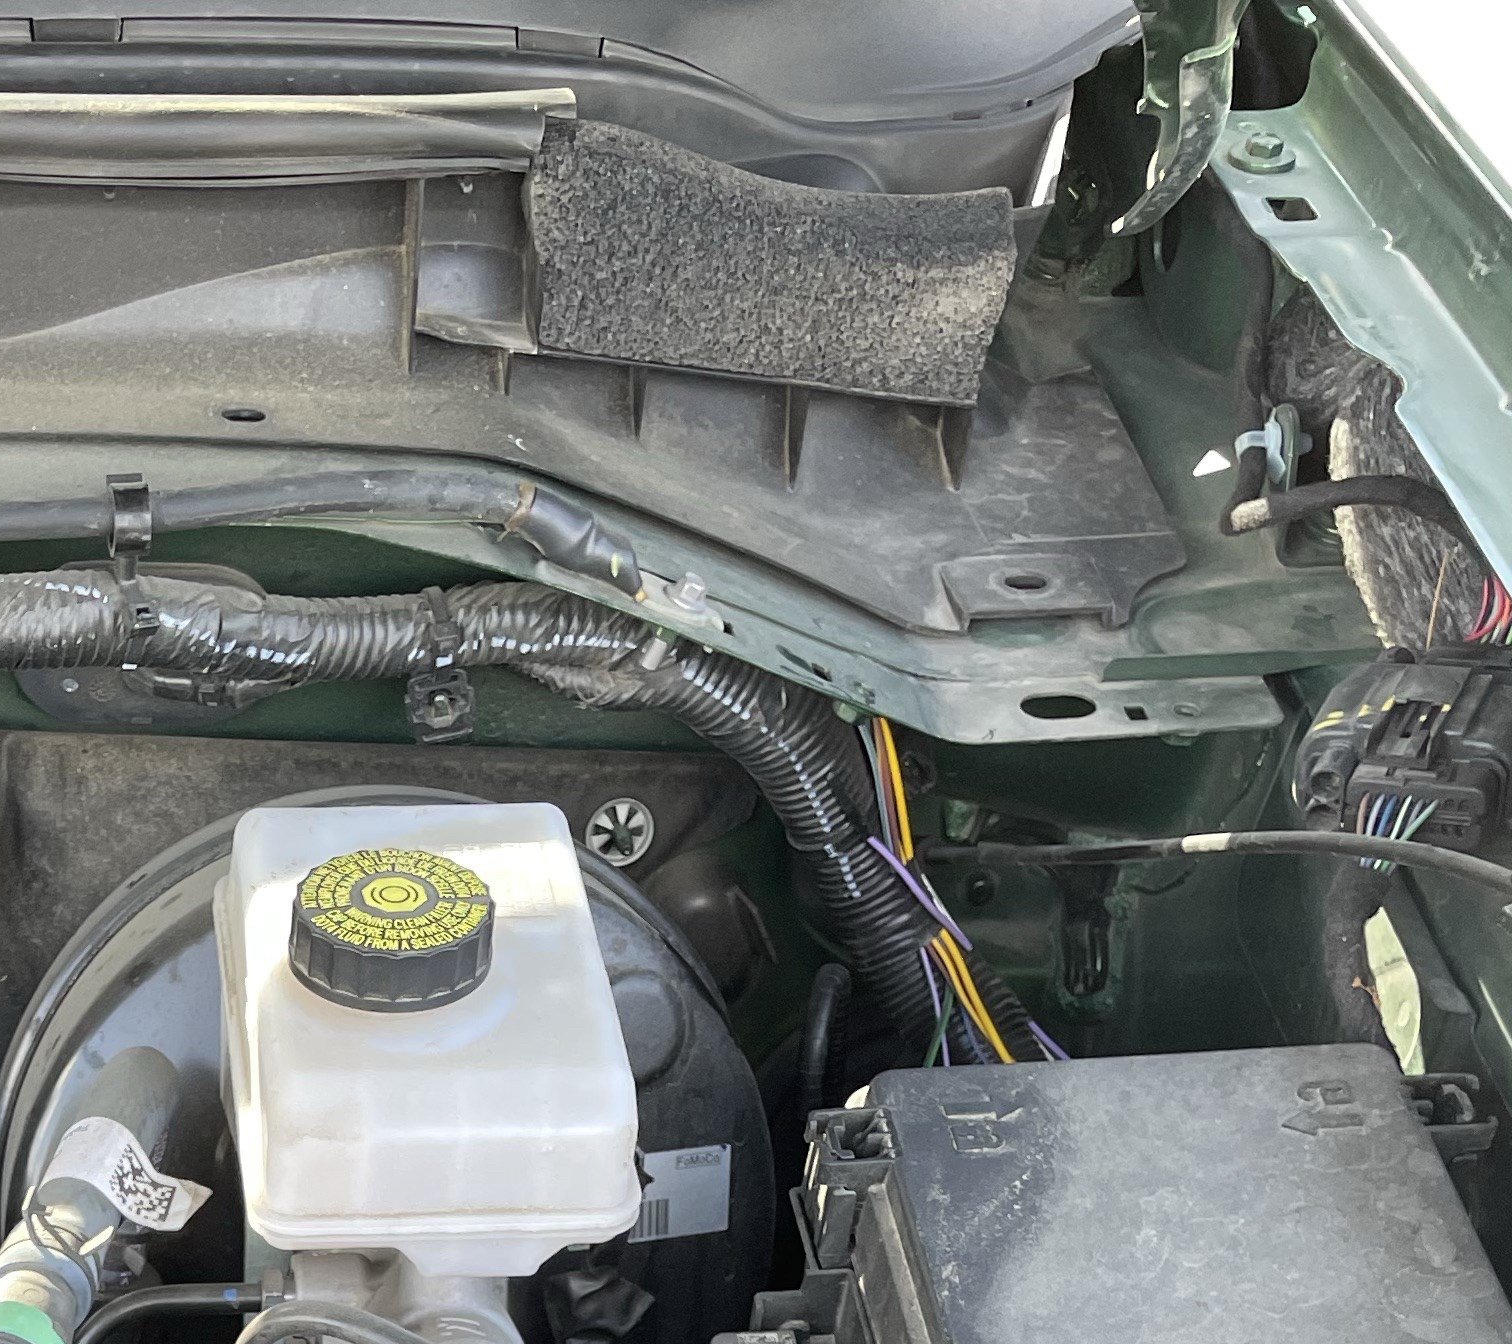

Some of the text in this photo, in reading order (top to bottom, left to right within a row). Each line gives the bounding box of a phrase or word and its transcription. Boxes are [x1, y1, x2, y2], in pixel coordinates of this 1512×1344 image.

[343, 918, 383, 938] BEFORE
[383, 924, 441, 940] REMOVING
[364, 936, 398, 950] FROM
